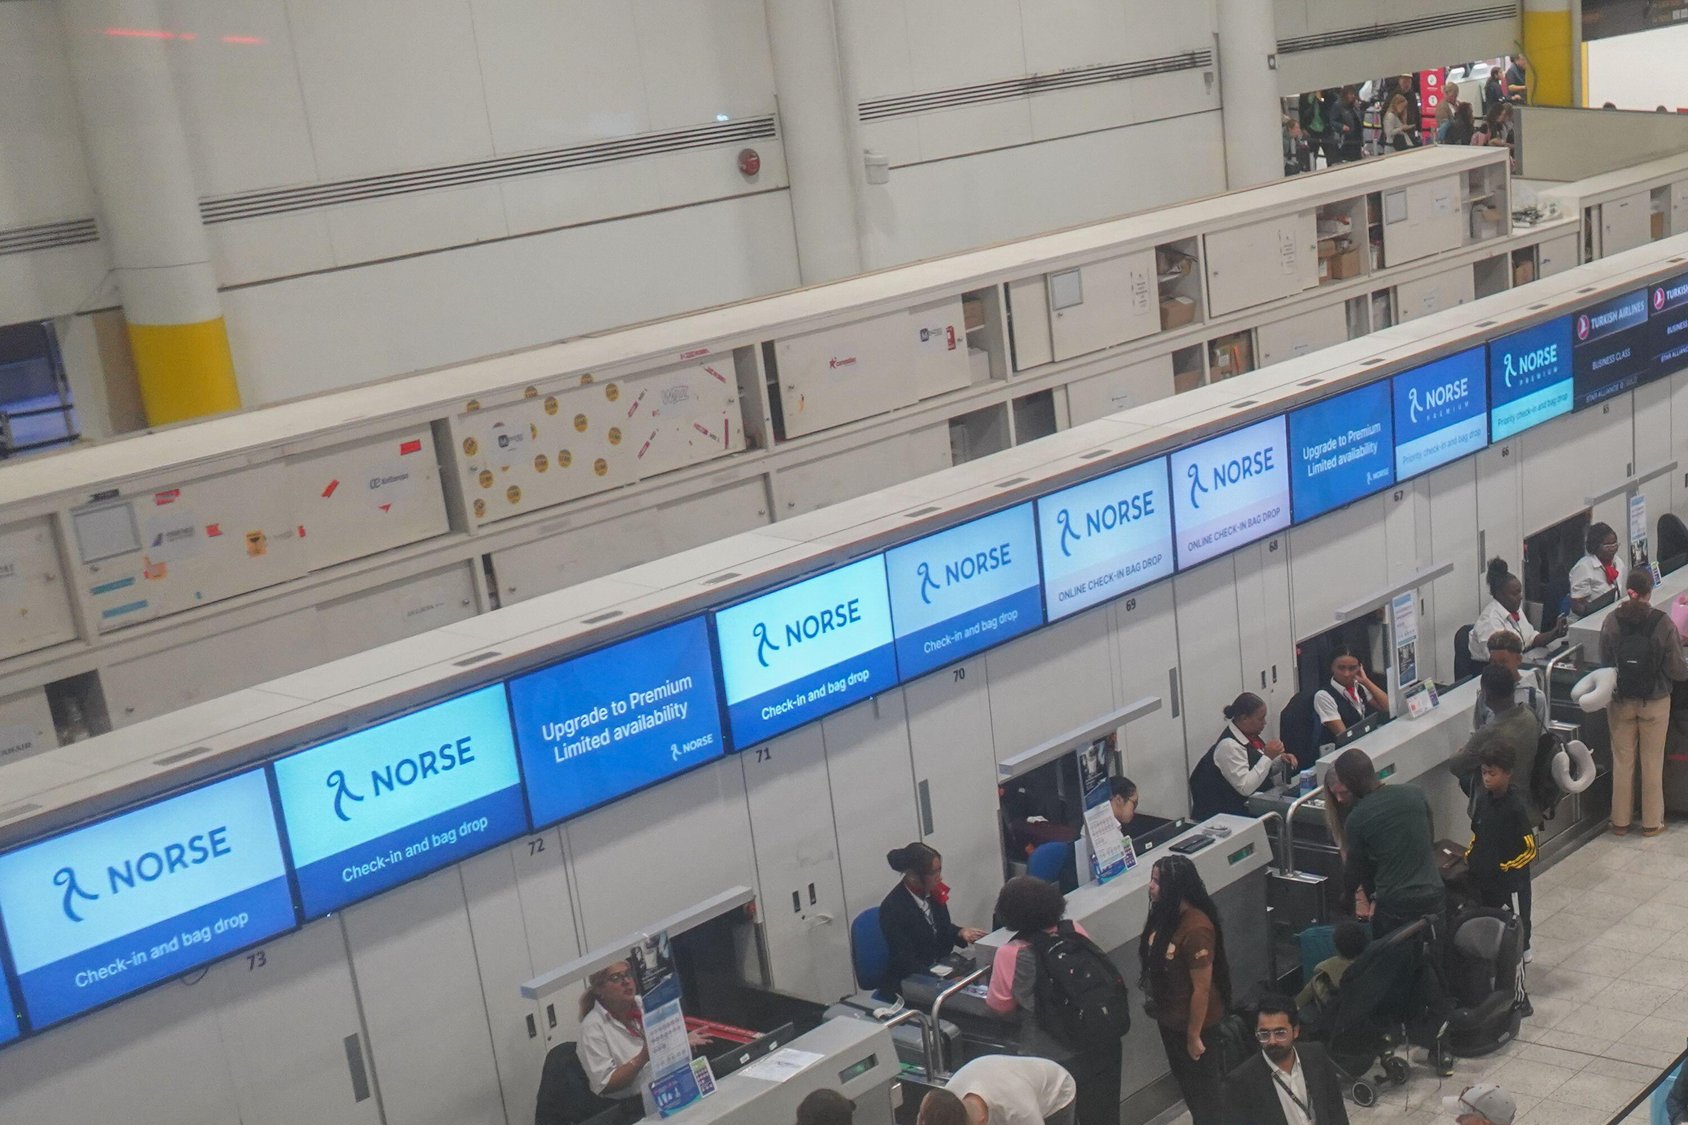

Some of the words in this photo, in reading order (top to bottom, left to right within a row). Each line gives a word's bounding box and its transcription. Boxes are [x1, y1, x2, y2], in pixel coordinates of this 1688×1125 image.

[1591, 309, 1618, 330] TURKISH
[1619, 300, 1645, 318] AIRLINES
[1667, 319, 1688, 335] BUSINESS
[1520, 344, 1558, 374] NORSE
[1592, 353, 1615, 370] BUSINESS
[1616, 348, 1631, 361] CLASS
[1426, 378, 1468, 410] NORSE
[1303, 438, 1337, 460] Upgrade
[1338, 435, 1347, 447] to
[1347, 422, 1382, 443] Premium
[1307, 455, 1337, 477] Limited
[1338, 441, 1378, 466] availability
[1214, 447, 1274, 490] NORSE
[1086, 490, 1154, 537] NORSE
[1394, 490, 1404, 502] 67
[1188, 534, 1213, 552] ONLINE
[1214, 521, 1247, 541] CHECK-IN
[1248, 514, 1262, 528] BAG
[1262, 507, 1281, 522] DROP
[945, 543, 1012, 586] NORSE
[1059, 583, 1086, 602] ONLINE
[1088, 569, 1125, 590] CHECK-IN
[1126, 562, 1141, 576] BAG
[1142, 554, 1162, 569] DROP
[785, 599, 861, 647] NORSE
[1126, 598, 1137, 611] 69
[924, 631, 963, 653] Check-in
[964, 623, 980, 639] and
[981, 617, 998, 632] bag
[999, 610, 1018, 625] drop
[761, 691, 806, 721] Check-in
[808, 685, 826, 702] and
[828, 678, 847, 695] bag
[848, 669, 870, 686] drop
[953, 668, 965, 682] 70
[542, 706, 608, 741] Upgrade
[611, 699, 627, 716] to
[629, 675, 693, 710] Premium
[554, 728, 611, 764] Limited
[613, 701, 688, 741] availability
[682, 733, 714, 754] NORSE
[371, 736, 475, 797] NORSE
[756, 747, 771, 764] 71
[107, 826, 232, 894] NORSE
[342, 850, 402, 882] Check-in
[405, 837, 429, 858] and
[432, 828, 457, 847] bag
[459, 817, 488, 837] drop
[528, 838, 545, 856] 72
[75, 952, 148, 988] Check-in
[150, 935, 179, 959] and
[182, 926, 212, 948] bag
[214, 912, 249, 935] drop
[246, 950, 267, 972] 73
